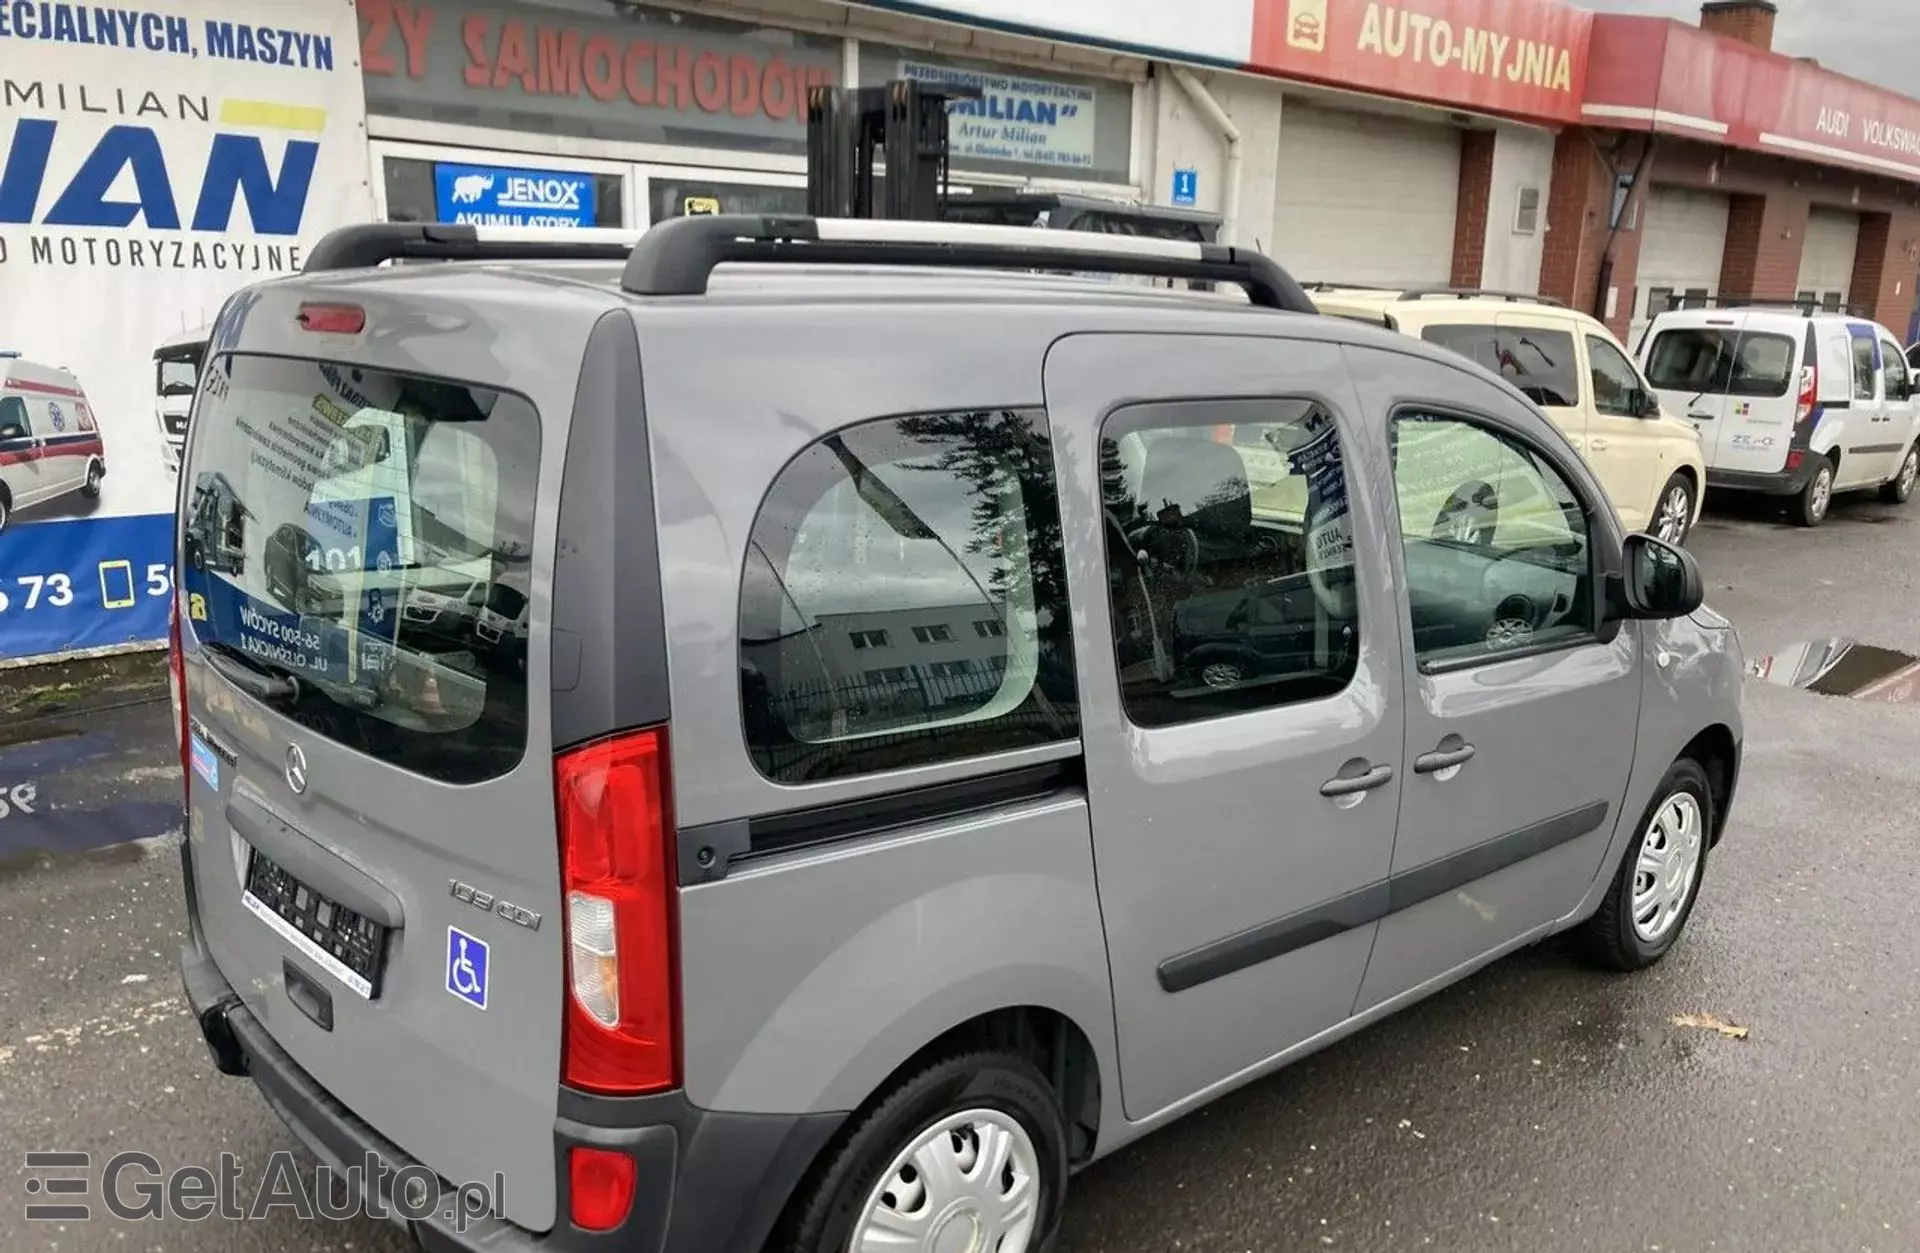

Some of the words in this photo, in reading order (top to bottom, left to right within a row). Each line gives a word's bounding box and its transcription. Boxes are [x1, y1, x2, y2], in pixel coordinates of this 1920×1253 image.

[206, 20, 333, 72] MASZYN
[1357, 1, 1571, 93] AUTO-MYJNIA
[4, 79, 209, 122] MILIAN
[958, 122, 998, 141] Artur
[1001, 124, 1047, 145] Milian
[1816, 106, 1850, 136] AUDI
[497, 177, 580, 207] JENOX
[1181, 173, 1189, 193] 1
[455, 212, 582, 229] AKUMULATORY
[31, 236, 302, 273] MOTORYZACYJNE
[17, 572, 74, 610] 73
[496, 900, 542, 932] CDI
